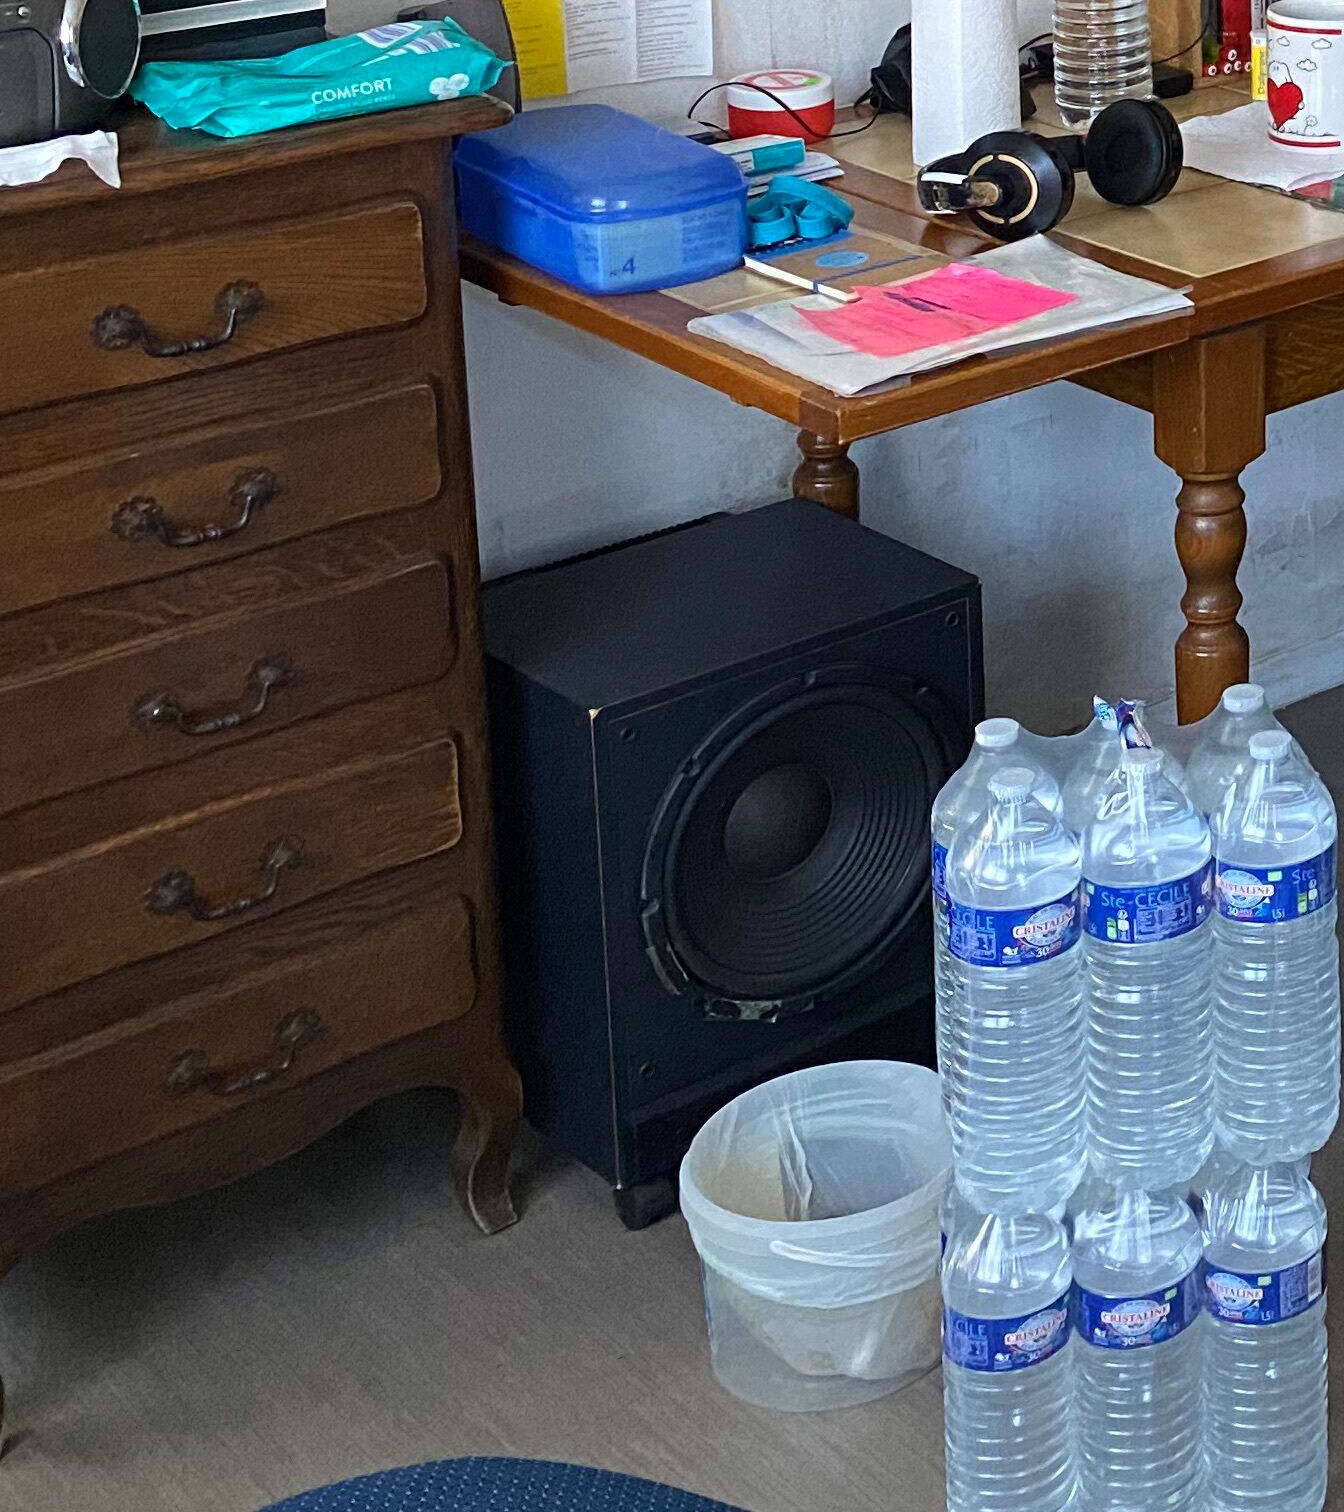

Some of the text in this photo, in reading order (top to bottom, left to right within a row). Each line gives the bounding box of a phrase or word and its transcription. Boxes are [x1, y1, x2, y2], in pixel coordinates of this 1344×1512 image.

[311, 76, 394, 107] COMFORT
[1014, 905, 1076, 938] CRISTALINE
[1103, 1304, 1169, 1323] CRISTALINE
